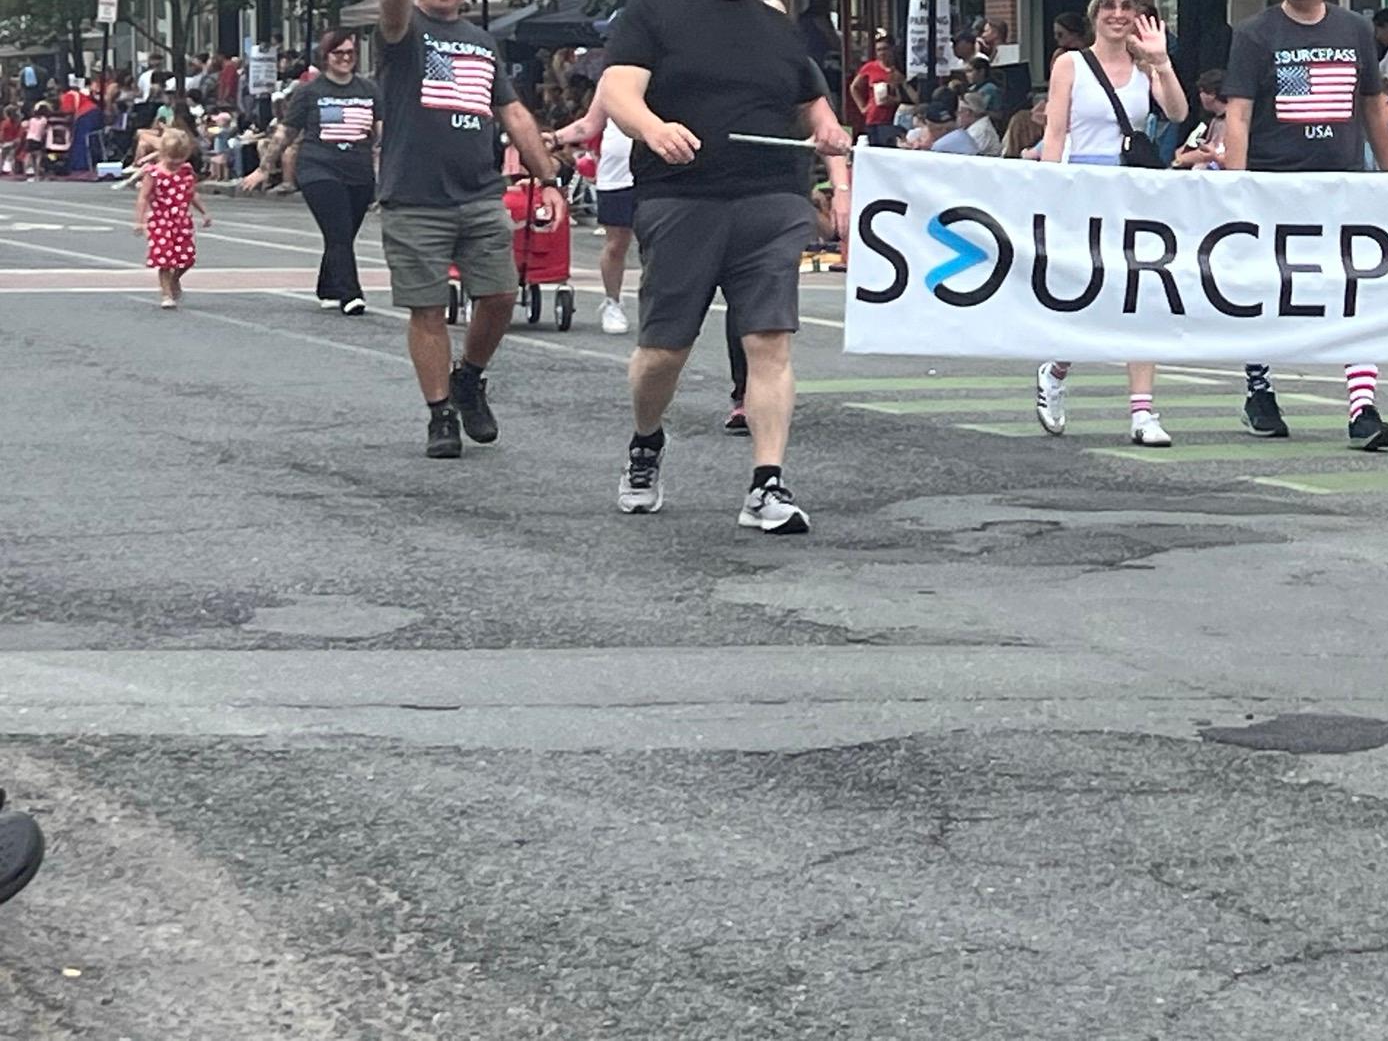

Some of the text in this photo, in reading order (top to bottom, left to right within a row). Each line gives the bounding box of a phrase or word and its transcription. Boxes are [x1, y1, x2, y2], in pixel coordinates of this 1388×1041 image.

[910, 15, 949, 26] PARNG
[1274, 47, 1357, 65] SOURCEPASS
[451, 113, 481, 130] USA
[1304, 125, 1333, 139] USA
